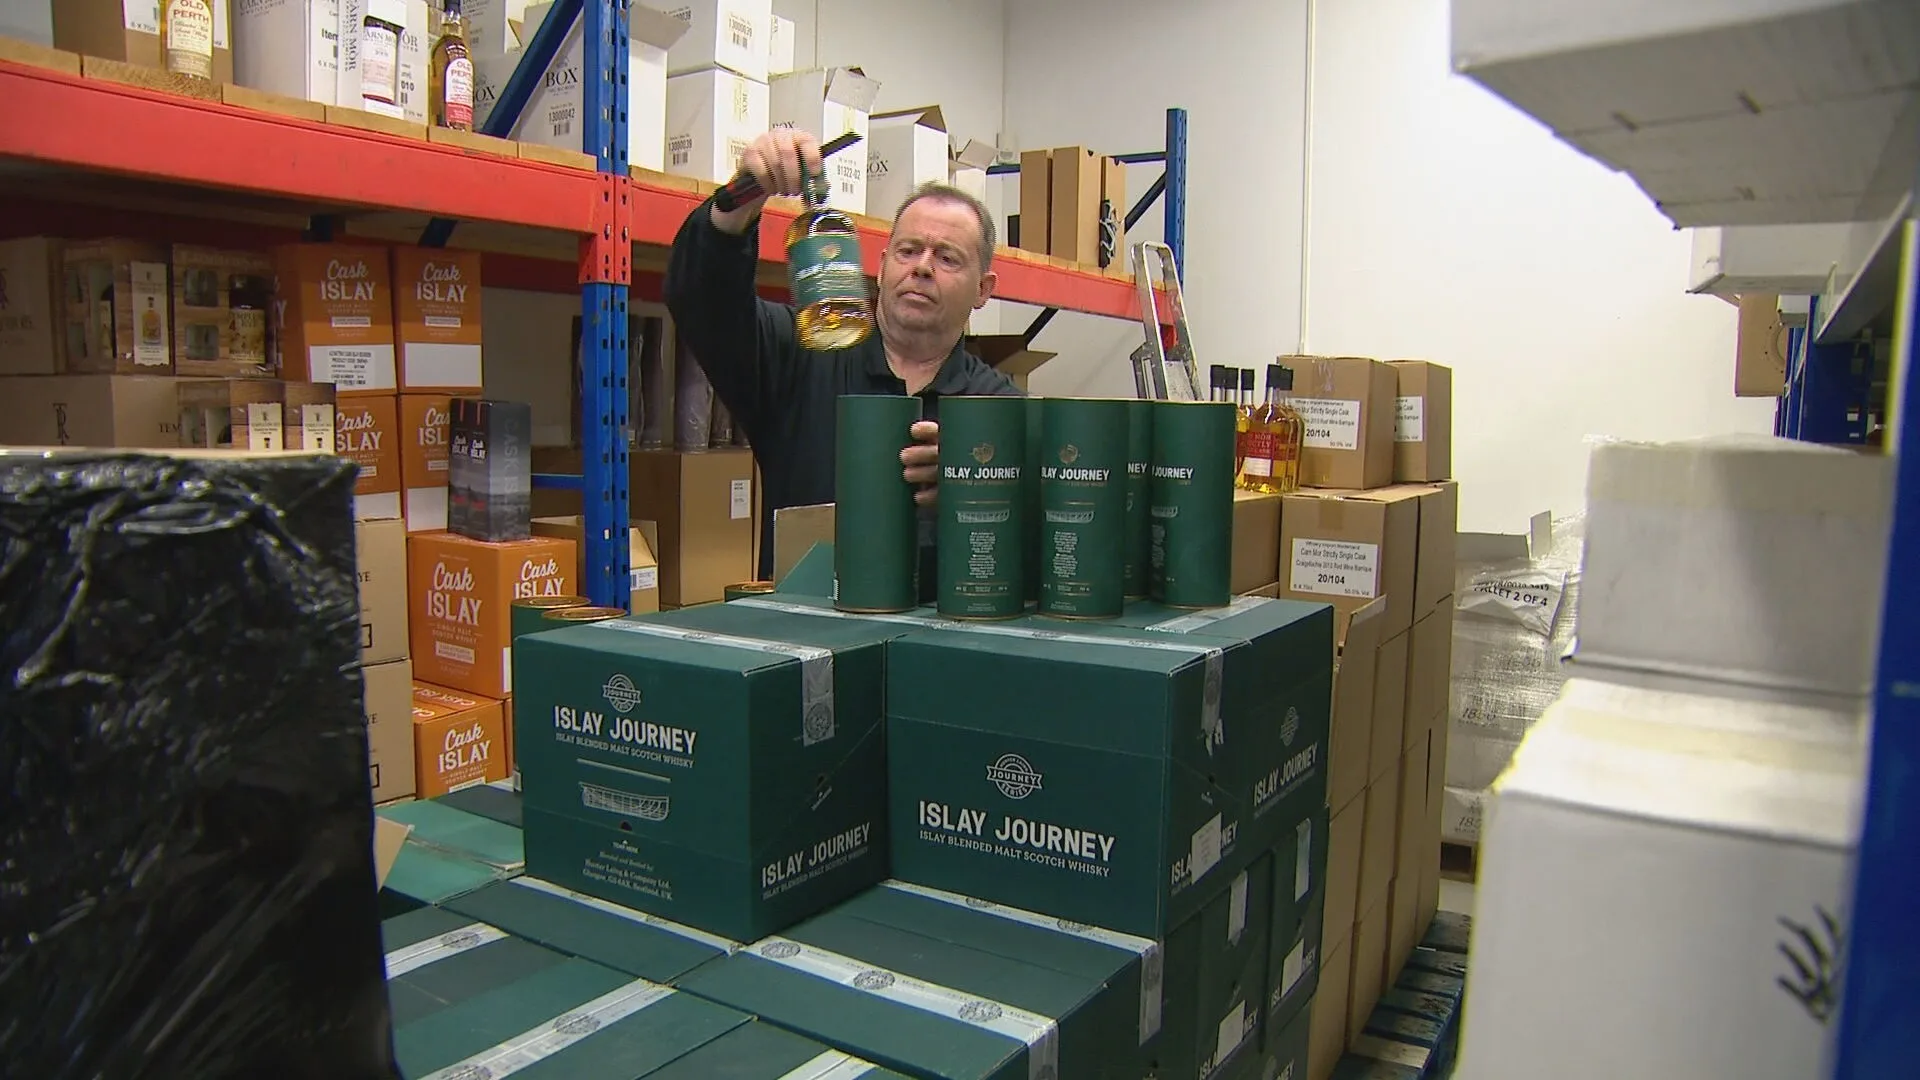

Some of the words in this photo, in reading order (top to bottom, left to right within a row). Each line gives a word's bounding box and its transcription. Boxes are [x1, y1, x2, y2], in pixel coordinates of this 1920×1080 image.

[180, 0, 204, 11] OLD
[174, 9, 210, 24] PERTH
[402, 29, 418, 47] ÒR
[545, 67, 578, 88] BOX
[473, 85, 496, 102] OX
[867, 159, 889, 174] OX
[326, 260, 369, 280] Cask
[422, 262, 462, 283] Cask
[321, 280, 377, 302] ISLAY
[416, 282, 468, 303] ISLAY
[424, 407, 450, 427] Cas
[336, 431, 383, 453] SLAY
[417, 426, 449, 446] ISL
[1306, 427, 1331, 438] 20/104
[945, 466, 972, 479] ISLAY
[974, 466, 1021, 479] JOURNEY
[1059, 468, 1110, 481] JOURNEY
[1127, 463, 1148, 474] NEY
[1155, 467, 1194, 480] JOURNEY
[432, 561, 476, 592] Cask
[521, 558, 559, 582] Cask
[1318, 573, 1345, 585] 20/104
[427, 590, 483, 627] ISLAY
[1513, 591, 1521, 602] 2
[1523, 594, 1540, 605] OF
[1540, 597, 1548, 606] 4
[445, 722, 485, 752] Cask
[554, 705, 604, 736] ISLAY
[609, 716, 697, 755] JOURNEY
[438, 739, 491, 774] ISLAY
[555, 732, 575, 744] ISLAY
[576, 736, 610, 751] BLENDED
[610, 743, 631, 756] MALT
[631, 750, 663, 763] SCOTCH
[663, 754, 695, 769] WHISKY
[993, 769, 1037, 786] JOURNEY
[1253, 767, 1280, 807] ISLAY
[1280, 742, 1319, 786] JOURNEY
[1000, 782, 1030, 797] SERIES
[919, 799, 987, 837] ISLAY
[995, 816, 1116, 862] JOURNEY
[762, 850, 805, 888] ISLAY
[808, 822, 871, 867] JOURNEY
[919, 829, 946, 844] ISLAY
[947, 836, 993, 854] BLENDED
[994, 844, 1023, 861] MALT
[1023, 850, 1066, 869] SCOTCH
[1067, 858, 1110, 878] WHISKY
[1171, 852, 1193, 885] ISLA
